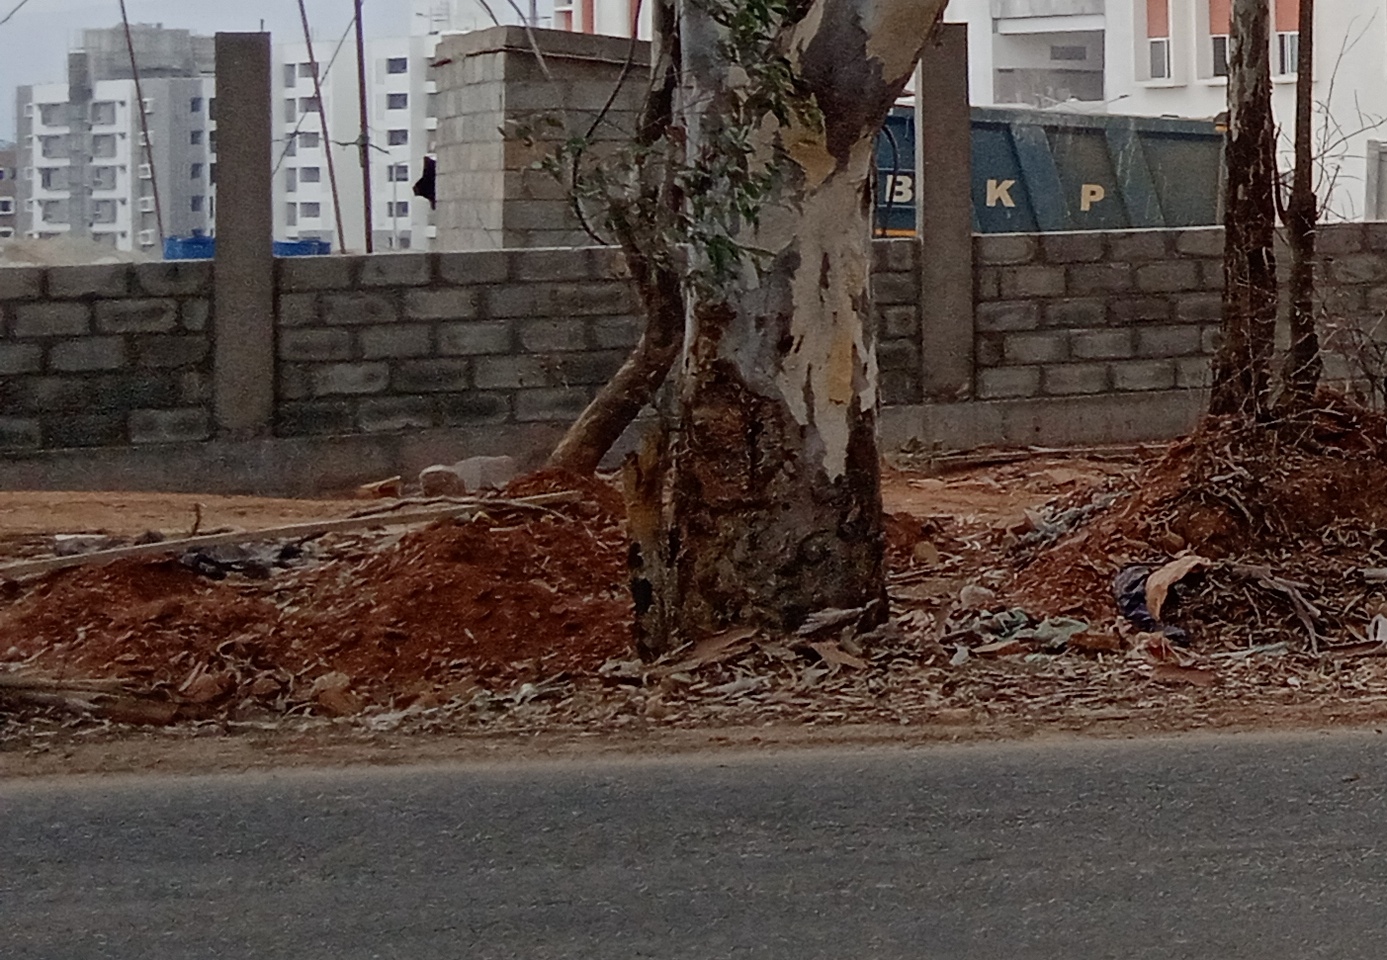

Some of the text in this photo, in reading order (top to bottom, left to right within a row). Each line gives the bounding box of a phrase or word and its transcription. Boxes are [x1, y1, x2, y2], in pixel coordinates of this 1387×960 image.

[885, 175, 1106, 212] B K P
